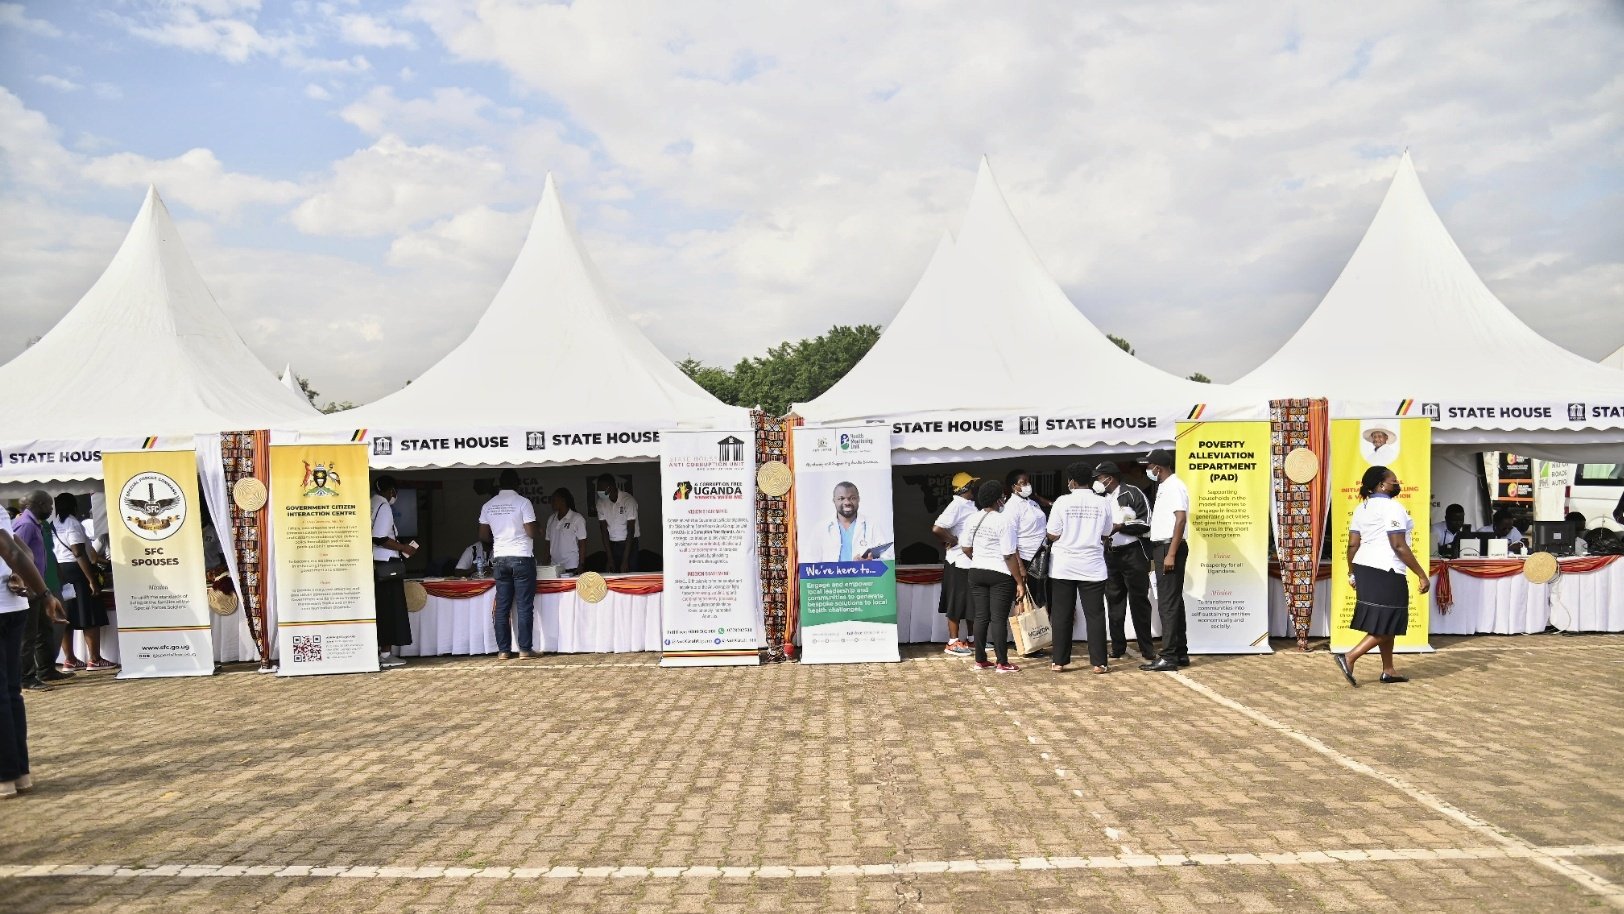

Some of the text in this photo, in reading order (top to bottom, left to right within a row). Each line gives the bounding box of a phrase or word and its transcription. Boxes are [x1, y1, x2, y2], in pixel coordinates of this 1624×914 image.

[1449, 407, 1551, 418] STATE HOUSE
[893, 420, 1004, 434] STATE HOUSE
[1046, 417, 1157, 431] STATE HOUSE
[552, 431, 660, 446] STATE HOUSE
[400, 436, 509, 451] STATE HOUSE
[1198, 440, 1246, 449] POVERTY
[9, 450, 102, 464] STATE HOUS
[1188, 452, 1254, 460] ALLEVIATION
[1189, 462, 1257, 470] DEPARTMENT
[1210, 473, 1238, 483] (PAD)
[694, 486, 742, 495] UGANDA
[146, 505, 160, 513] SFC
[144, 548, 164, 556] SFC
[132, 558, 180, 567] SPOUSES
[806, 564, 835, 576] We're
[836, 566, 859, 574] here
[806, 582, 830, 590] Engage
